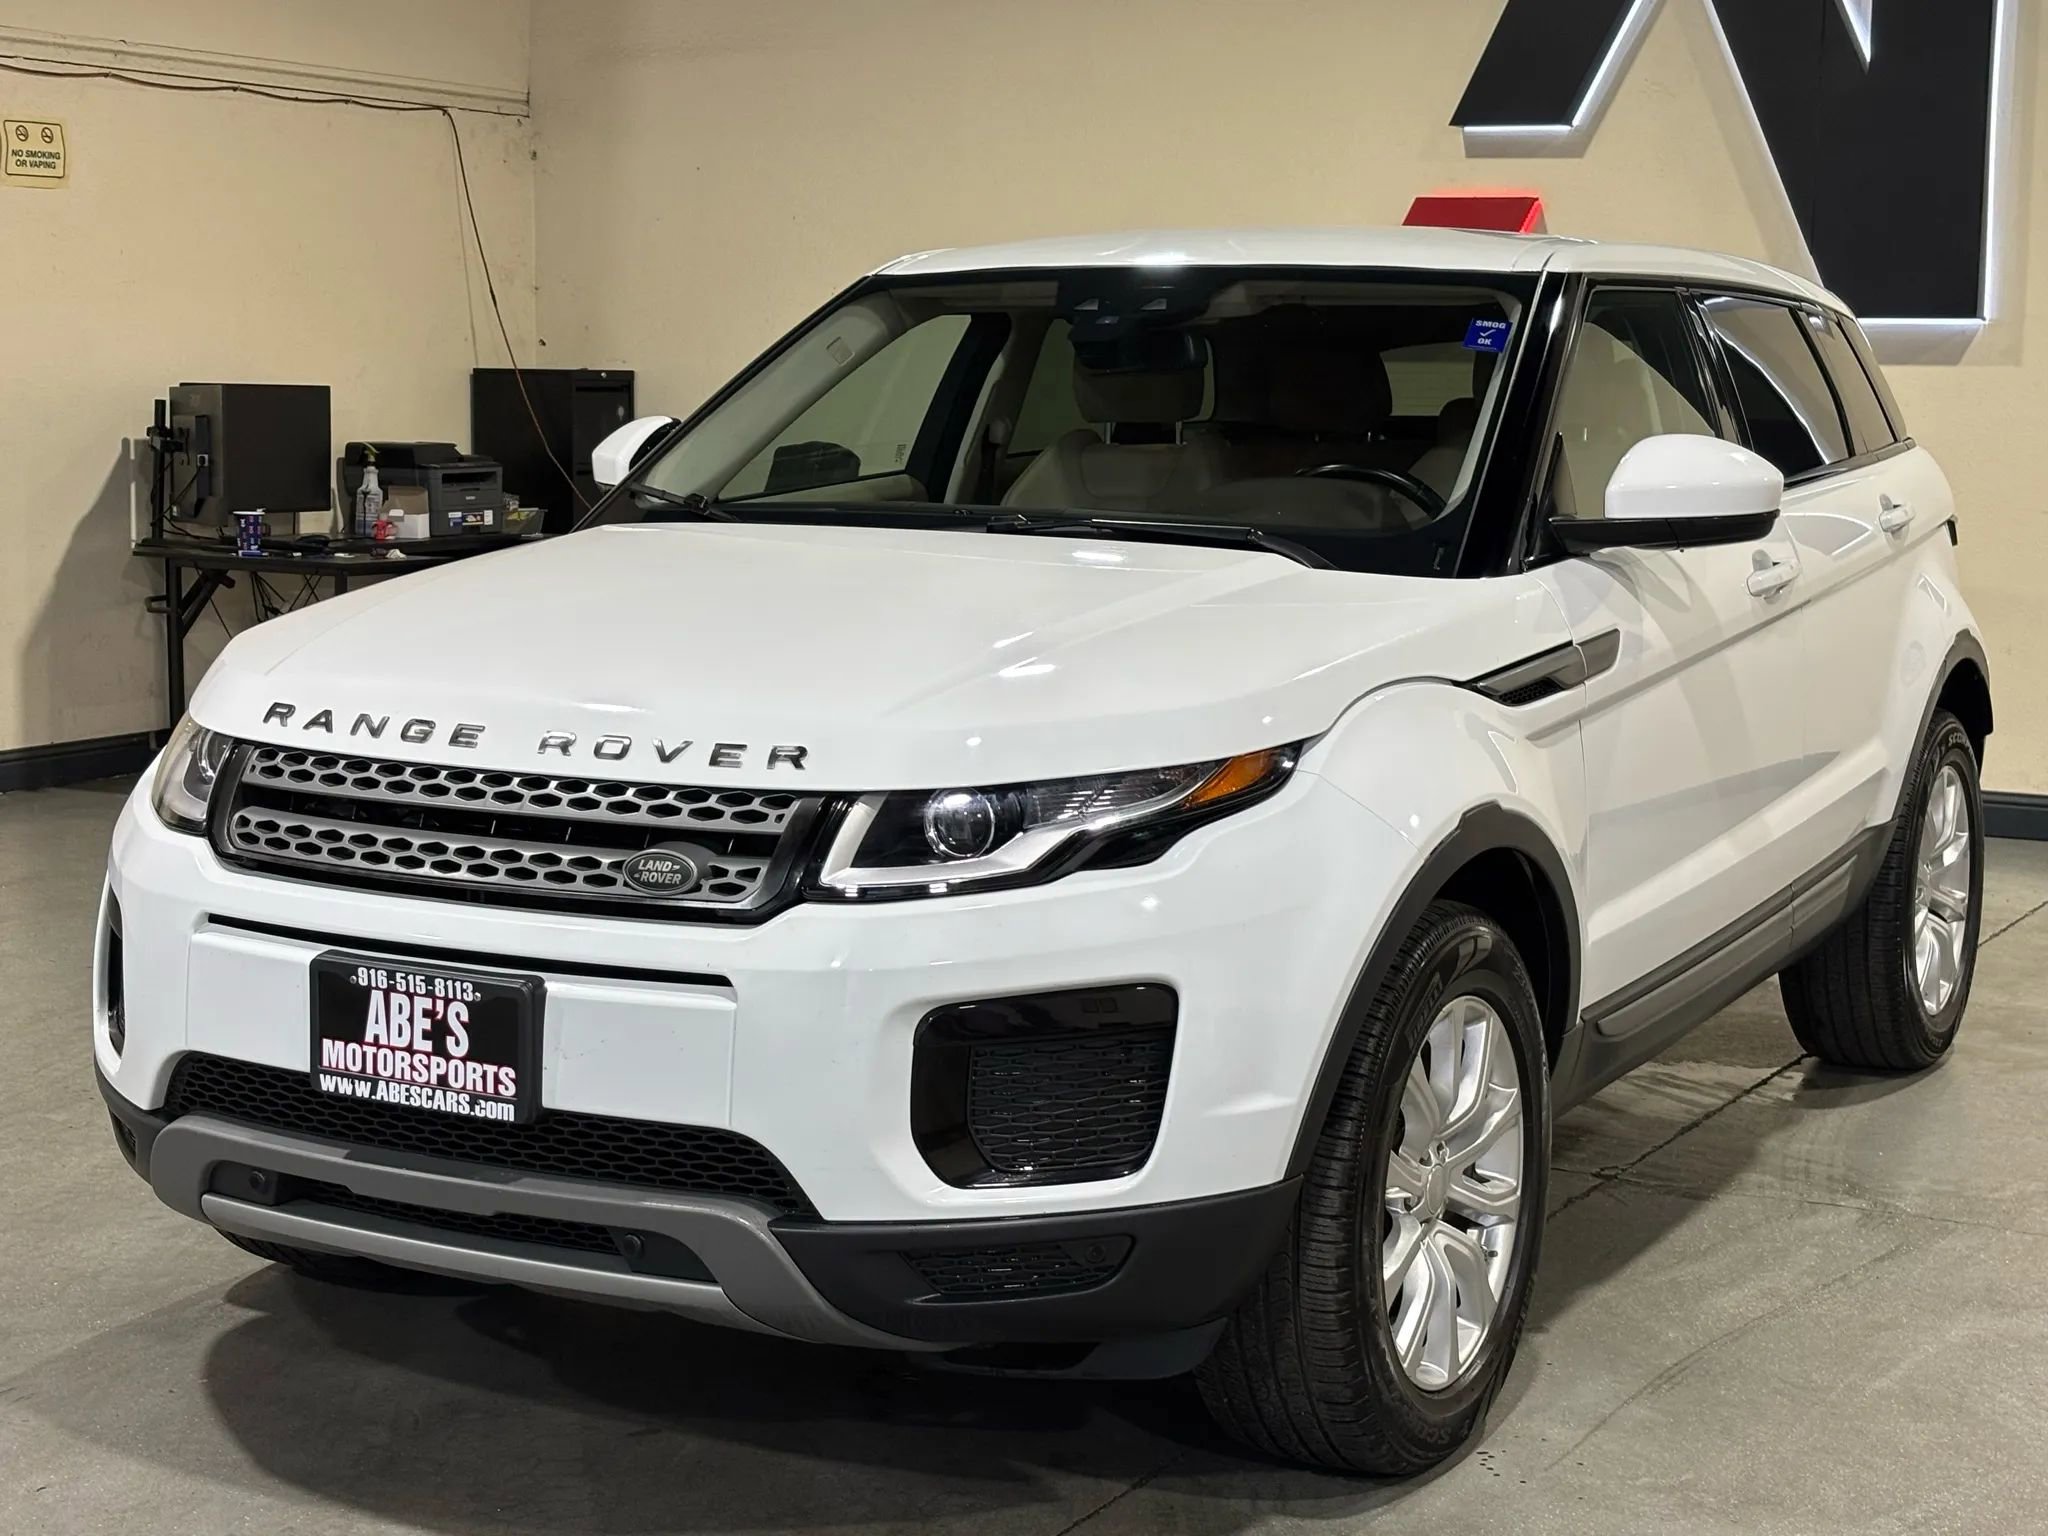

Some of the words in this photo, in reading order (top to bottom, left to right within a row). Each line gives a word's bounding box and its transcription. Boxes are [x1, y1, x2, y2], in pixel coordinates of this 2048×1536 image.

[11, 149, 24, 157] NO
[25, 150, 61, 160] SMOKING
[15, 159, 28, 167] OR
[29, 160, 56, 169] VAPING
[1475, 320, 1507, 329] SMOG
[1477, 337, 1493, 345] OK
[262, 702, 486, 749] RANGE
[537, 730, 809, 770] ROVER
[357, 966, 474, 1002] 916-515-8113
[364, 989, 470, 1058] ABE'S
[322, 1038, 516, 1097] MOTORSPORTS
